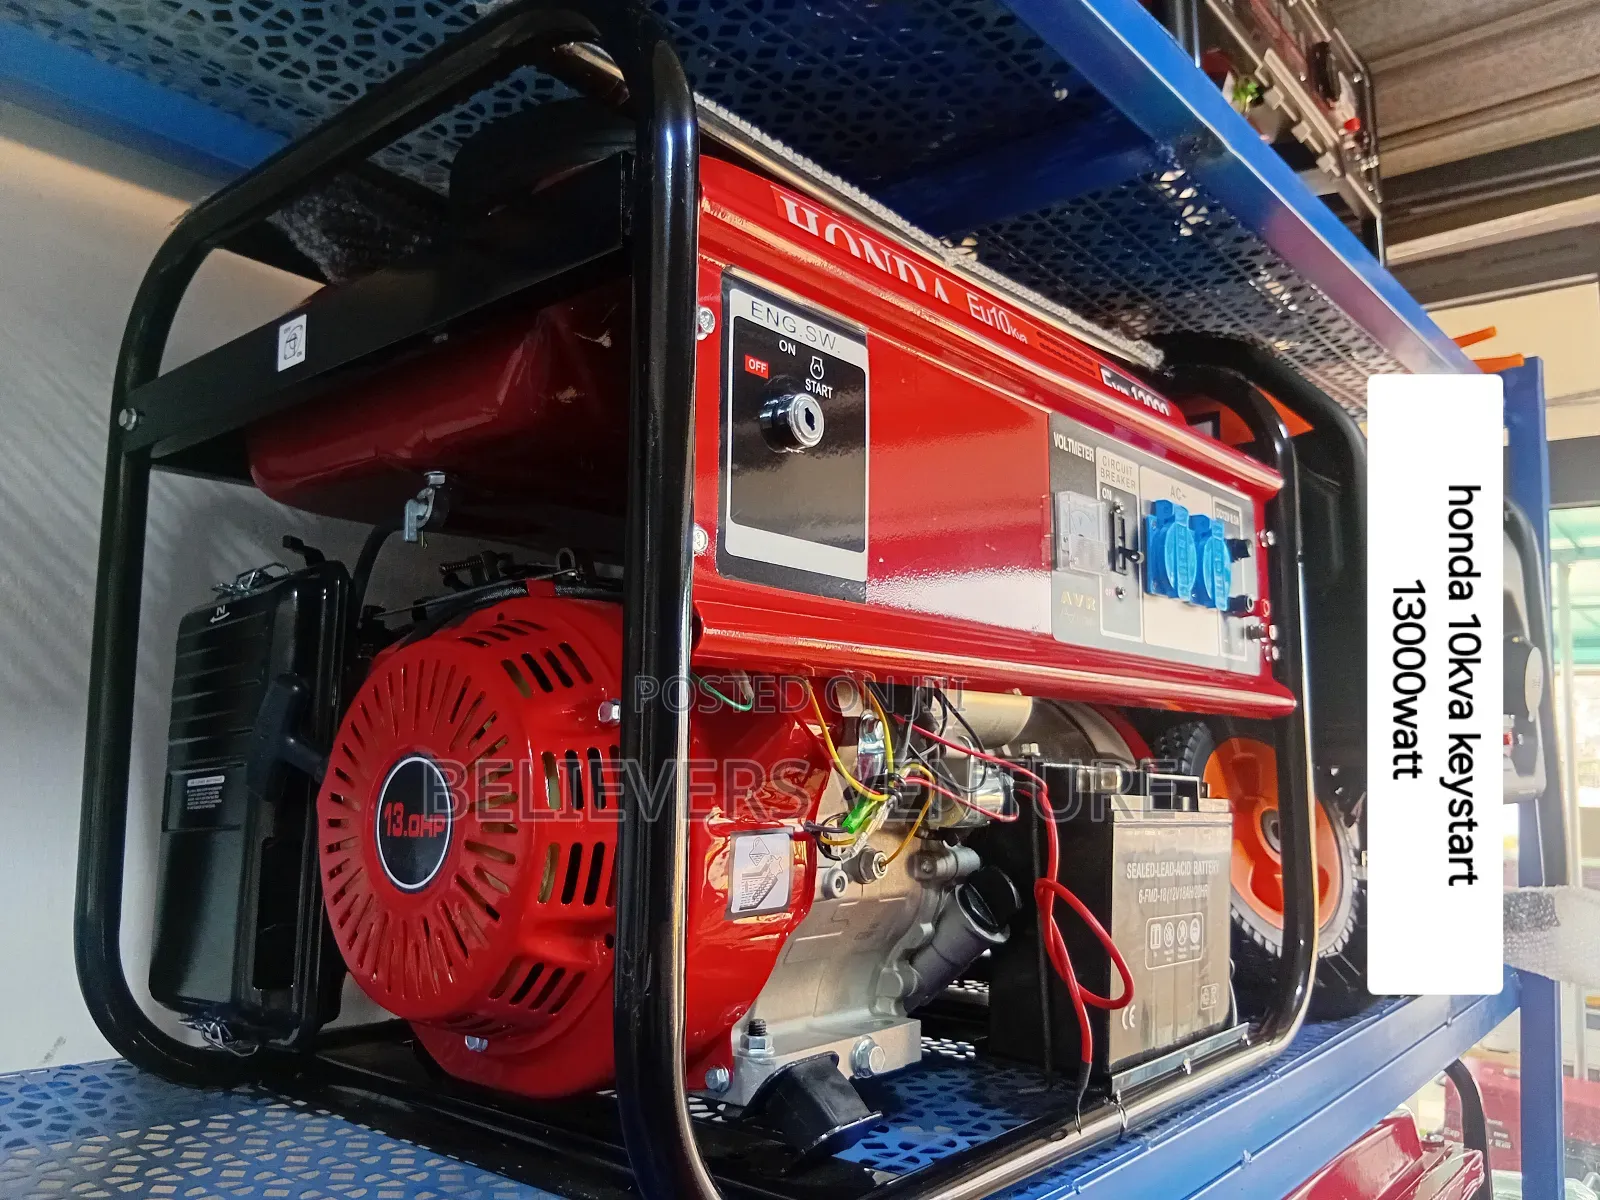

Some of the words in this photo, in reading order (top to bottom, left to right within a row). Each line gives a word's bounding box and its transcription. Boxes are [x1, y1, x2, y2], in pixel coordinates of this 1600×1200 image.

[779, 340, 796, 356] ON
[749, 359, 766, 373] OFF
[805, 378, 833, 398] START
[1053, 431, 1094, 463] VOLTMETER
[1102, 456, 1132, 477] CIRCUIT
[1100, 468, 1135, 489] BREAKER
[1101, 487, 1111, 501] ON
[384, 802, 446, 837] 13.0HP
[1193, 859, 1219, 876] BATTERY
